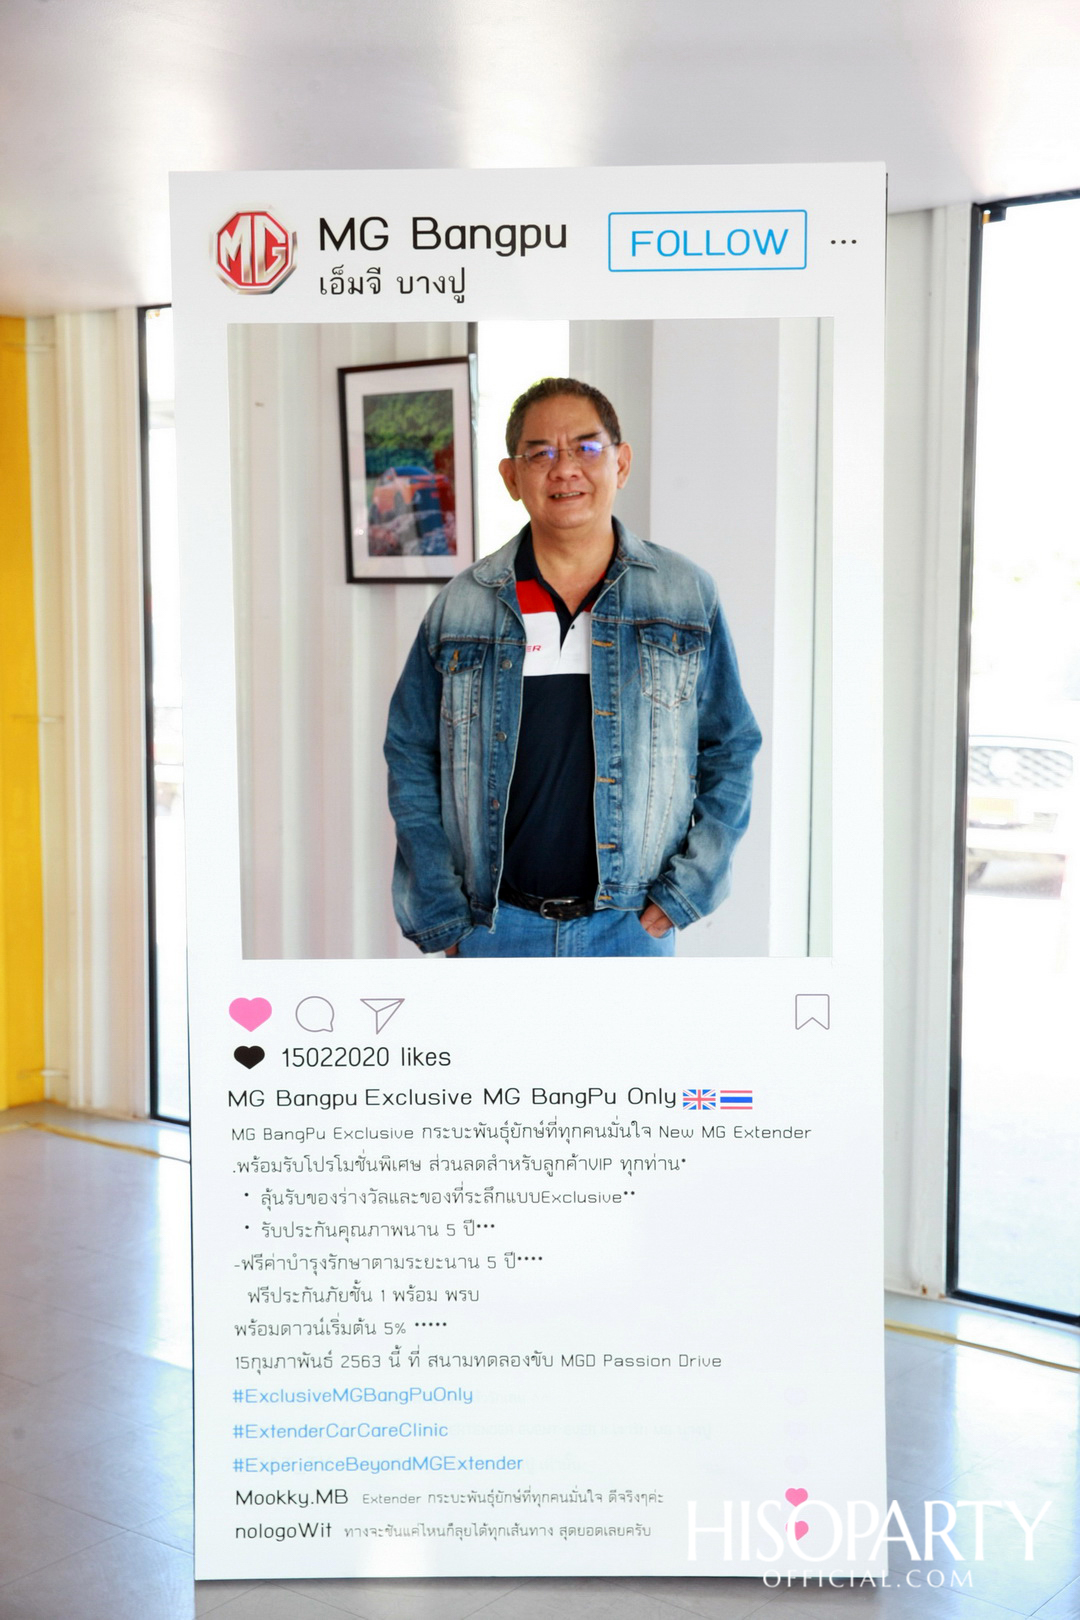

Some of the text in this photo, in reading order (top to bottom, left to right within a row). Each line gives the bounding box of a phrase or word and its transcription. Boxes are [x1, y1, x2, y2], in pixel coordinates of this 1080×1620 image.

[219, 214, 287, 284] MG
[319, 215, 567, 258] MG Bangpu
[630, 227, 790, 258] FOLLOW
[319, 263, 466, 305] เอ็มจี บางปู
[281, 1046, 452, 1068] 15022020 likes
[227, 1086, 677, 1111] MG Bangpu Exclusive MG BangPu Only
[231, 1116, 812, 1145] MG BangPu Exclusive กระบะพันธุ์ยักษ์ที่ทุกคนมั่นใจ New MG Extender
[261, 1220, 440, 1244] รับประกันคุณภาพนาน
[446, 1223, 456, 1237] 5
[487, 1255, 497, 1270] 5
[247, 1279, 480, 1304] ฟรีประกันภัยชั้น 1 พร้อม พรบ
[233, 1312, 377, 1337] พร้อมดาวน์เริ่มต้น
[383, 1321, 407, 1336] 5%
[235, 1350, 333, 1376] 15กุมภาพันธ์
[340, 1354, 381, 1369] 2563
[388, 1345, 402, 1368] นี้
[407, 1345, 421, 1368] ที่
[427, 1349, 554, 1368] สนามทดลองขับ
[603, 1353, 672, 1368] Passion
[678, 1353, 722, 1368] Drive
[232, 1386, 474, 1407] #ExclusiveMGBangPuOnly
[232, 1422, 449, 1439] #ExtenderCarCareClinic
[232, 1455, 524, 1476] #ExperienceBeyondMGExtender
[235, 1488, 349, 1509] Mookky.MB
[362, 1493, 422, 1505] Extender
[608, 1488, 664, 1507] ดีจริงๆค่ะ
[235, 1521, 333, 1543] nologoWit
[559, 1522, 652, 1541] สุดยอดเลยครับ
